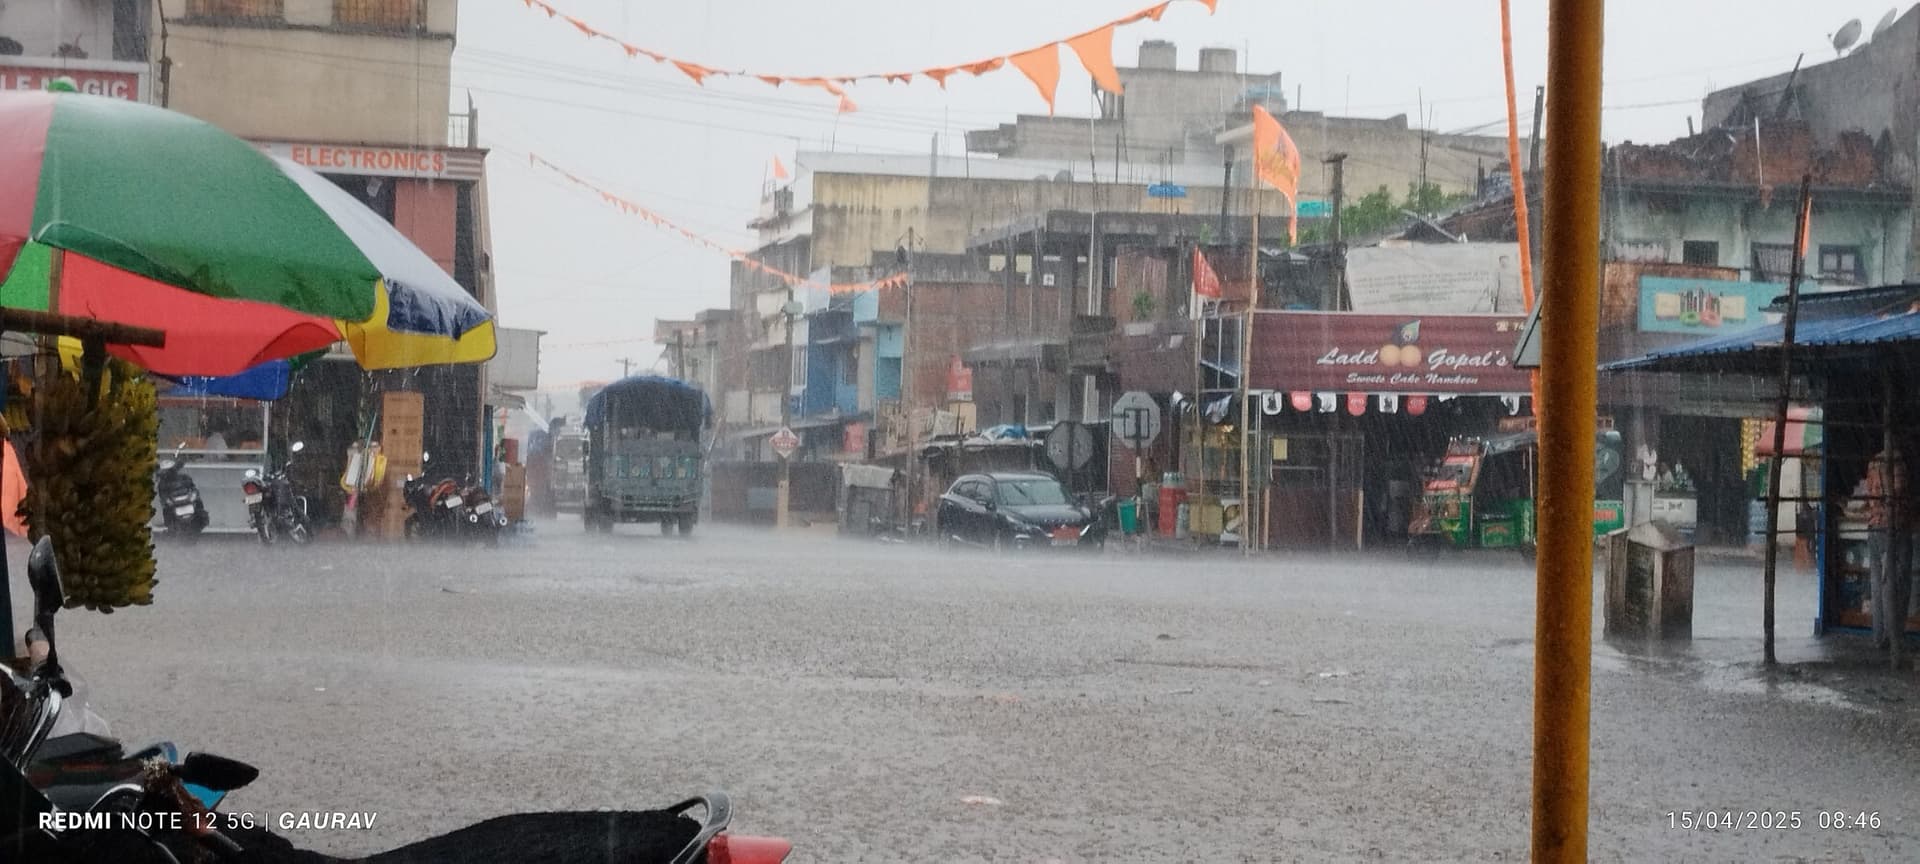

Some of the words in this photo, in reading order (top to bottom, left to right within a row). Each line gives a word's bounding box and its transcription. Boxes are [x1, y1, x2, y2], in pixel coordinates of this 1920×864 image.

[291, 144, 445, 171] ELECTRONICS
[1427, 348, 1509, 370] Gopal's
[1346, 372, 1385, 384] Sweets
[1390, 372, 1420, 385] Cake
[1424, 373, 1479, 385] Namkeen
